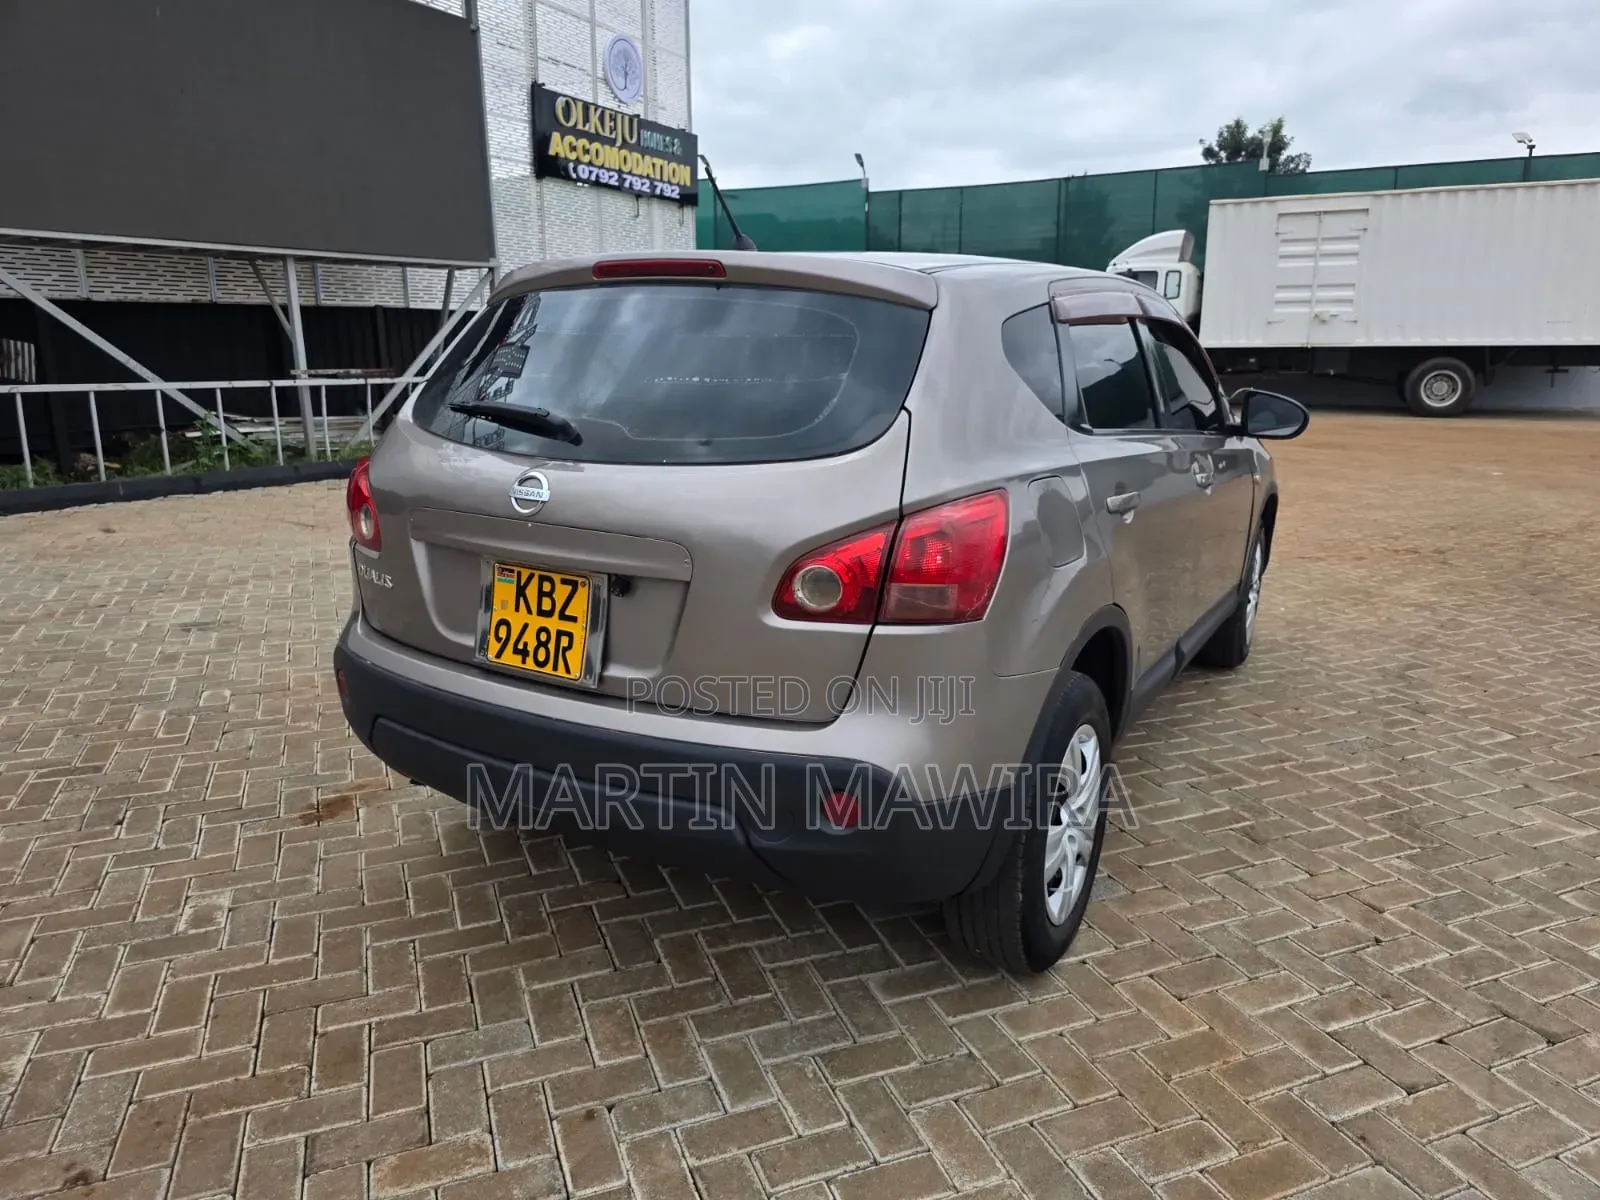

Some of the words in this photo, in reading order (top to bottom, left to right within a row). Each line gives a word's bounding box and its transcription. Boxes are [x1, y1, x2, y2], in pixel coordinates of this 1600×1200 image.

[555, 95, 639, 146] OLKEJU
[548, 131, 691, 187] ACCOMODATION
[576, 164, 619, 186] 0792
[621, 174, 651, 193] 792
[654, 182, 681, 199] 792
[511, 487, 544, 498] NISSAN
[514, 570, 579, 624] KBZ
[493, 619, 575, 675] 948R
